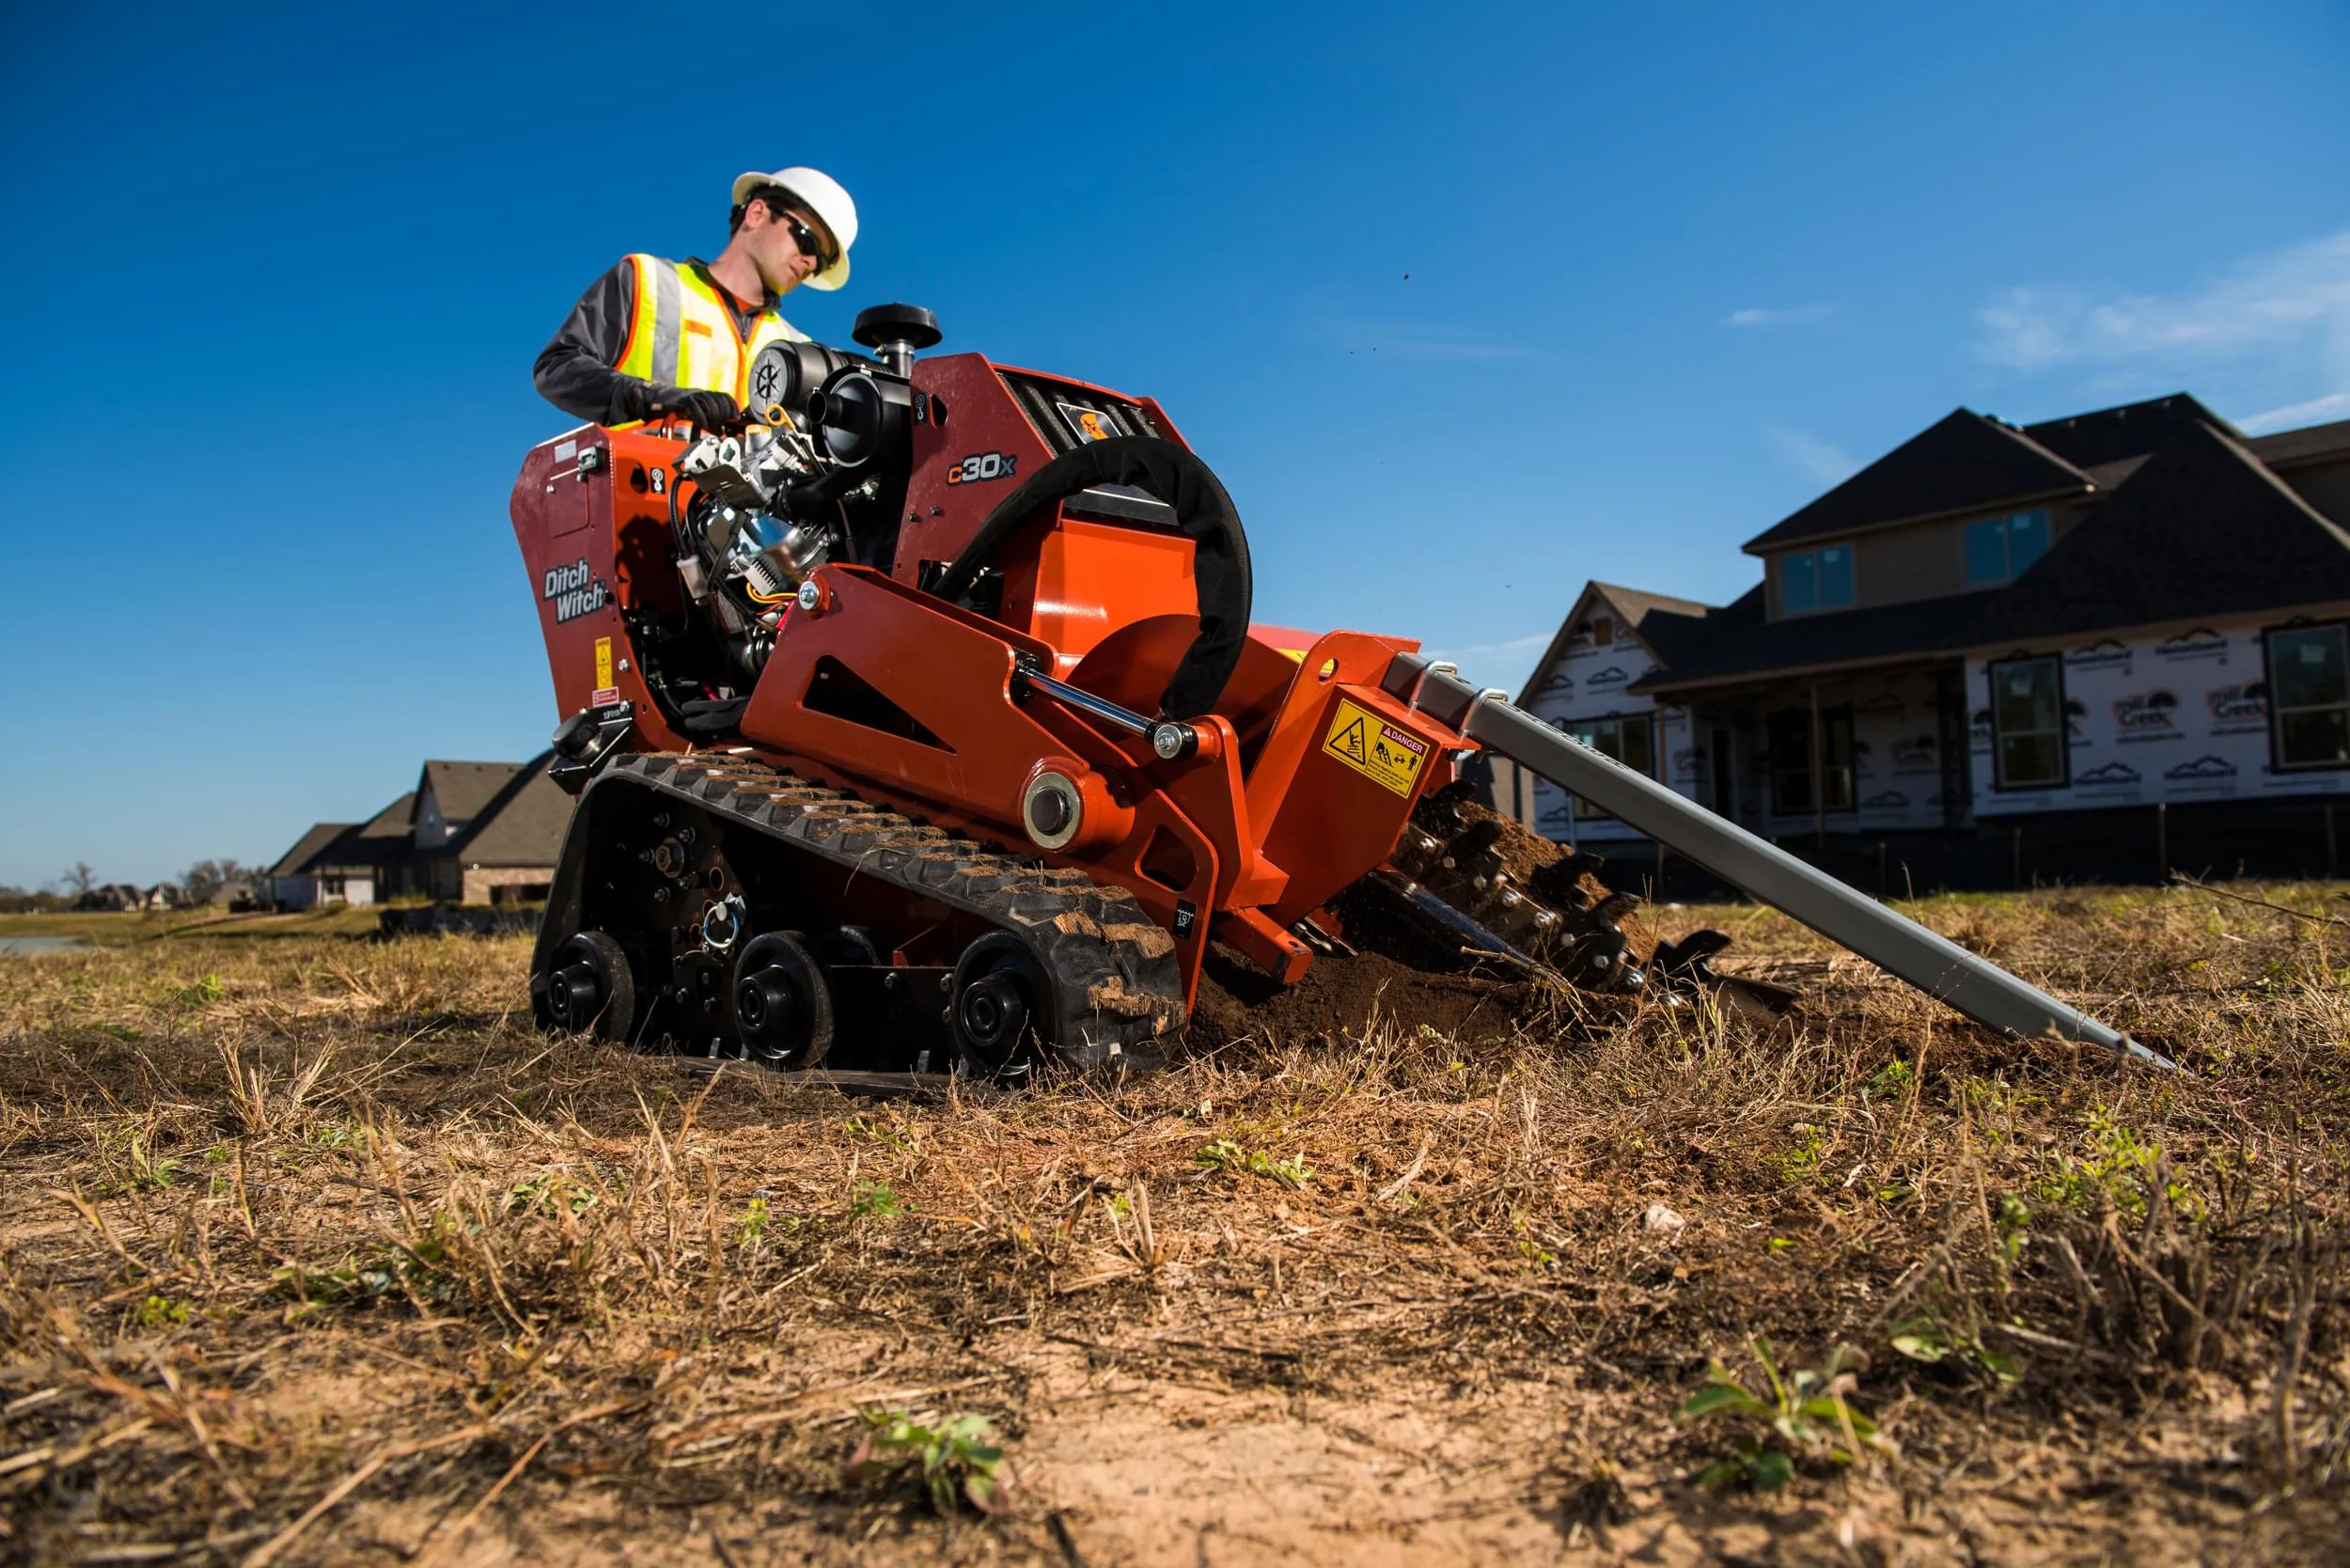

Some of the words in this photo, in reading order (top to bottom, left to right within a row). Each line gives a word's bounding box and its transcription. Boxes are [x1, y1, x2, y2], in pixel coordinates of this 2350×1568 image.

[544, 559, 588, 599] Ditch
[556, 582, 605, 621] Witch
[1390, 730, 1423, 754] DANGER
